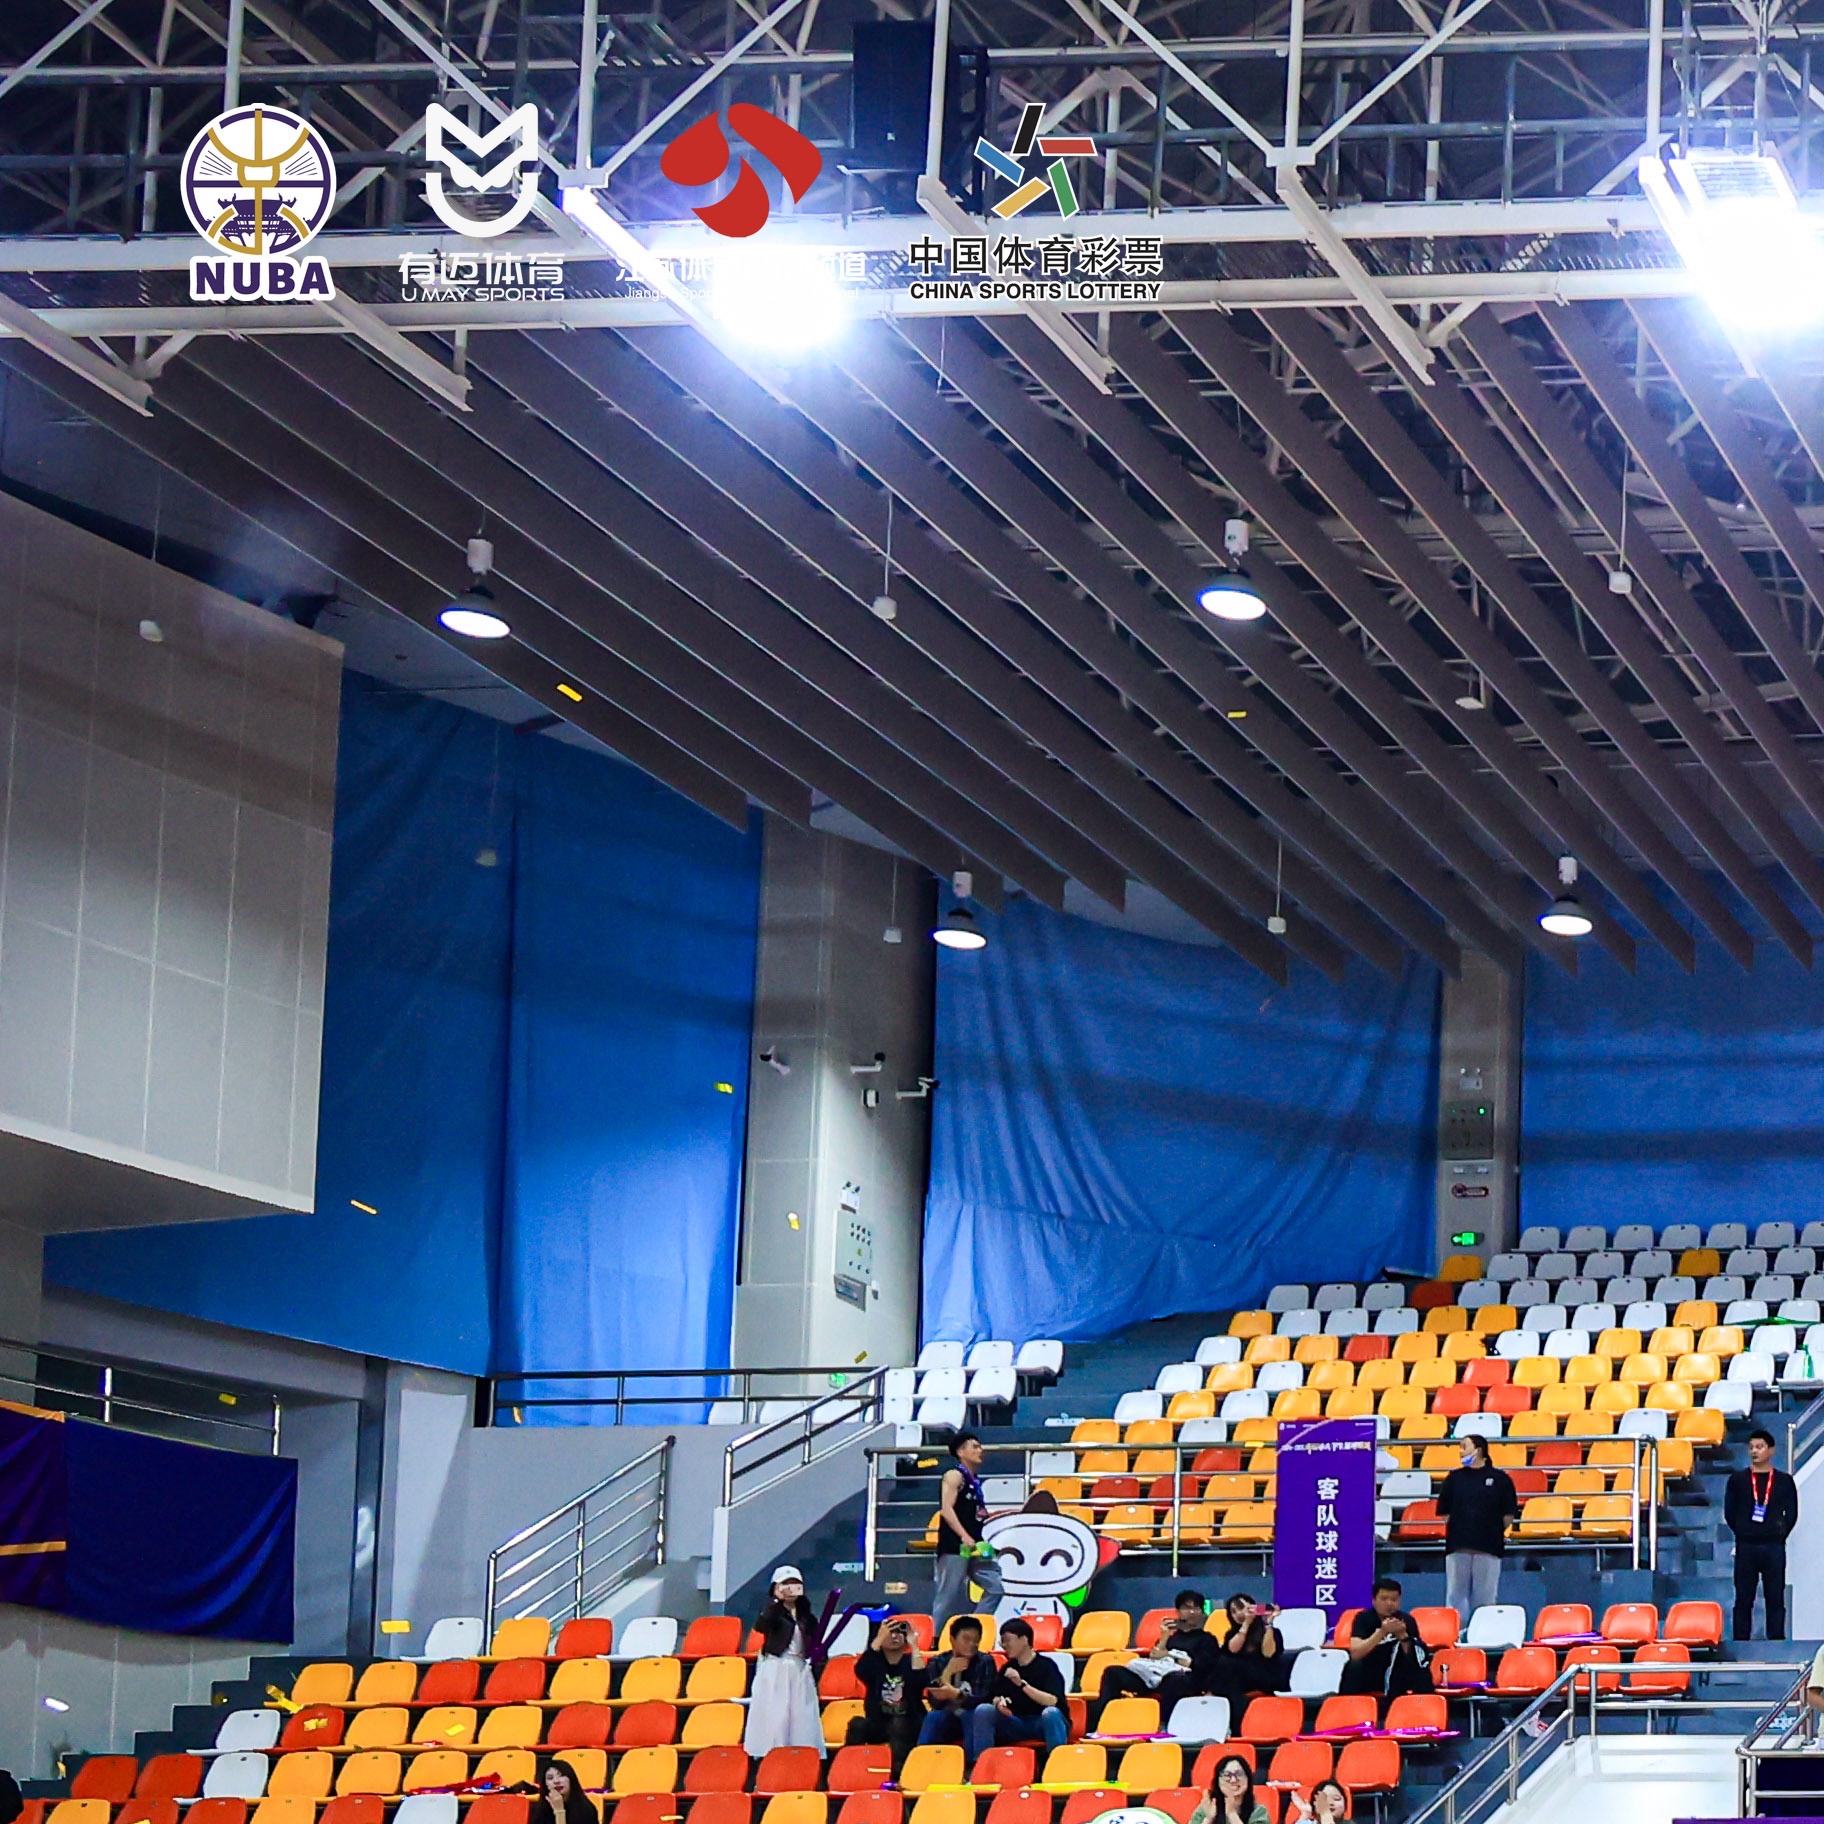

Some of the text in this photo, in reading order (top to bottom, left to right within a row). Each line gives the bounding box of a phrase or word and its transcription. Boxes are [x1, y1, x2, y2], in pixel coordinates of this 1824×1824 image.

[1314, 1477, 1340, 1606] 客队球迷区
